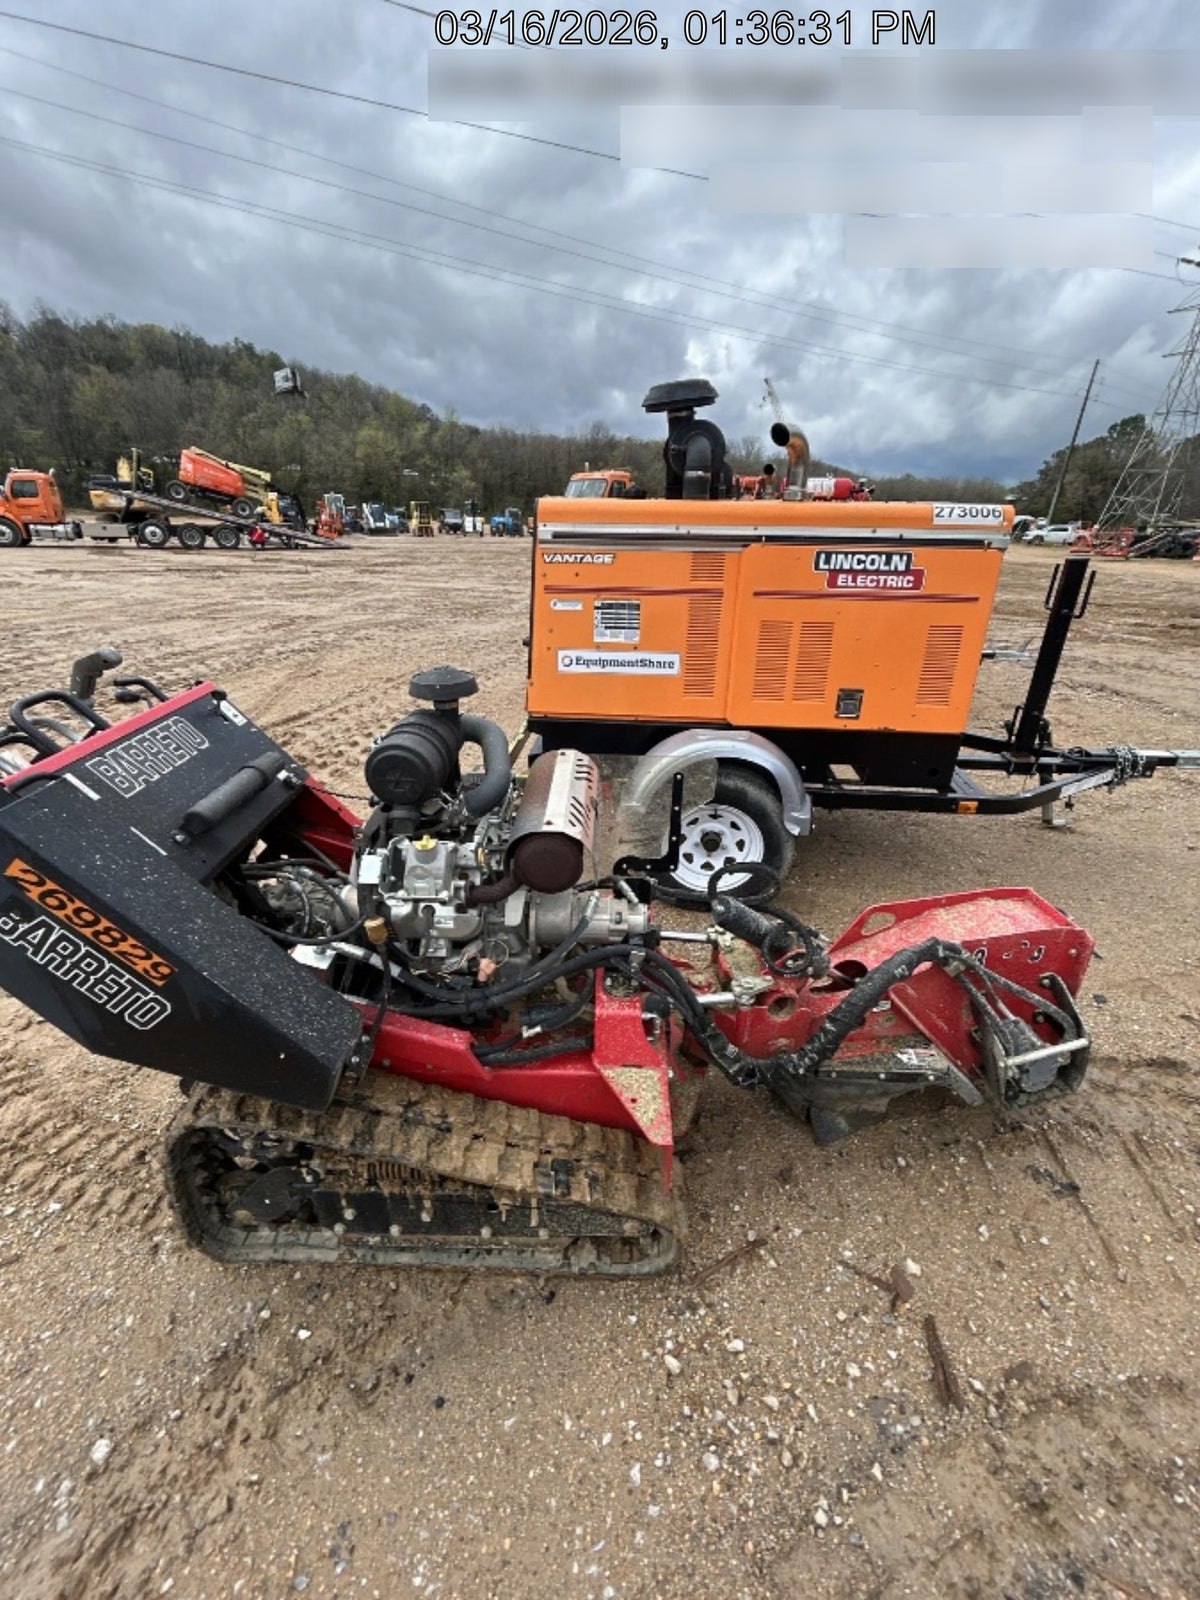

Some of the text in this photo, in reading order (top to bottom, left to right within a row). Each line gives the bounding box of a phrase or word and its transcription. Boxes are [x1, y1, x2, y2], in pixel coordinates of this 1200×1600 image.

[934, 504, 1002, 519] 273006
[542, 553, 615, 565] VANTAGE
[818, 553, 907, 571] LINCOLN
[837, 573, 915, 588] ELECTRIC
[574, 655, 675, 669] EquipmentShare
[85, 716, 209, 798] BARRETO
[15, 867, 176, 982] 269829
